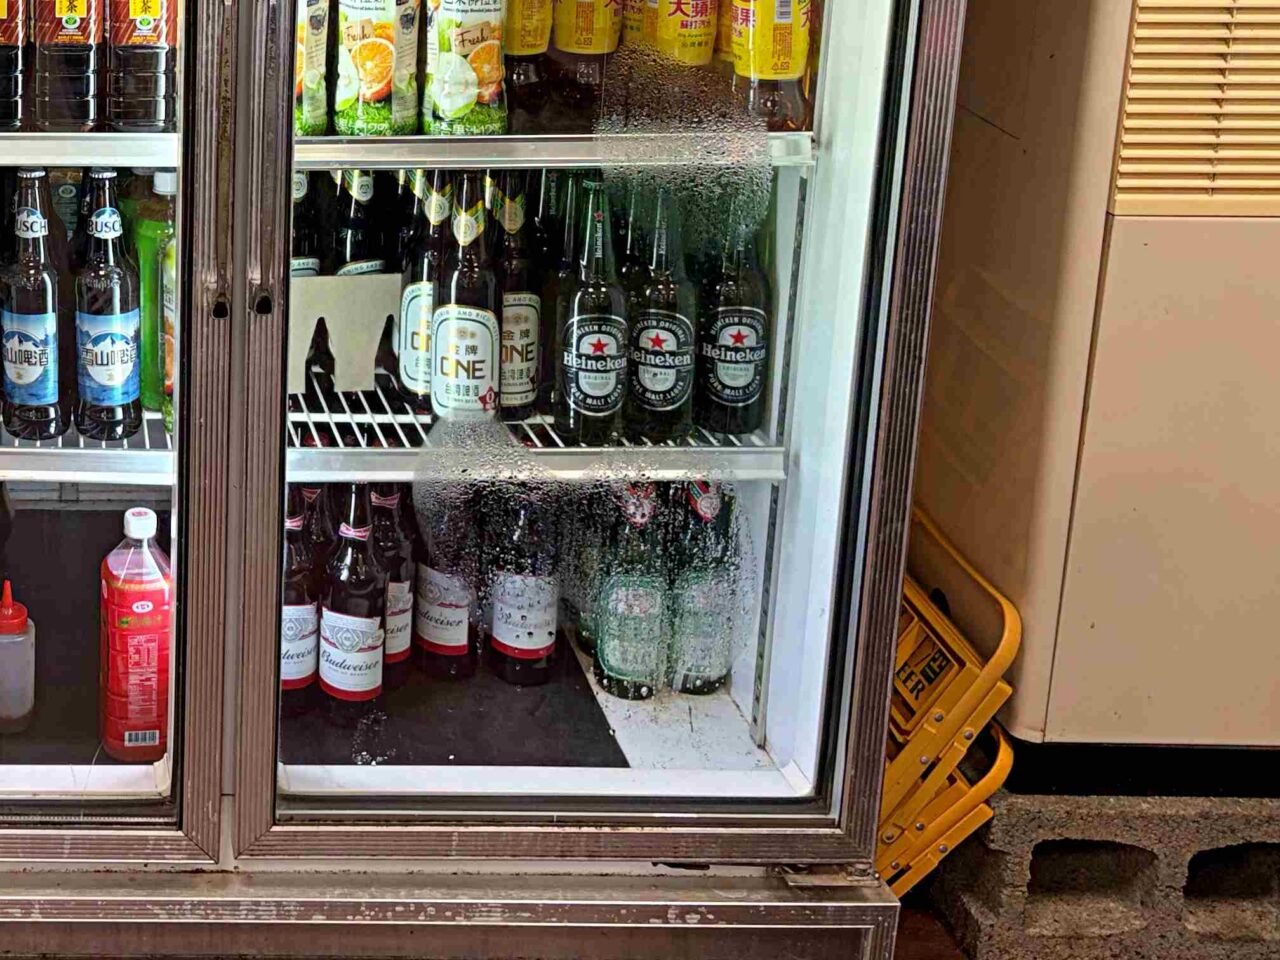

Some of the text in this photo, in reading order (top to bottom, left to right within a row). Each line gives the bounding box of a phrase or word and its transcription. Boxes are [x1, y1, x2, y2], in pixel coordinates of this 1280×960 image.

[456, 27, 489, 48] Fresh
[16, 217, 49, 233] USCH
[86, 218, 123, 234] BUSC
[594, 222, 603, 258] Heineken
[7, 347, 49, 367] 山啤酒
[563, 351, 627, 371] Heineken
[702, 342, 766, 362] Heineken
[440, 356, 486, 380] ONE
[645, 391, 664, 400] MALT
[723, 386, 743, 396] MALT
[585, 397, 605, 406] MALT
[321, 649, 380, 671] Budweiser
